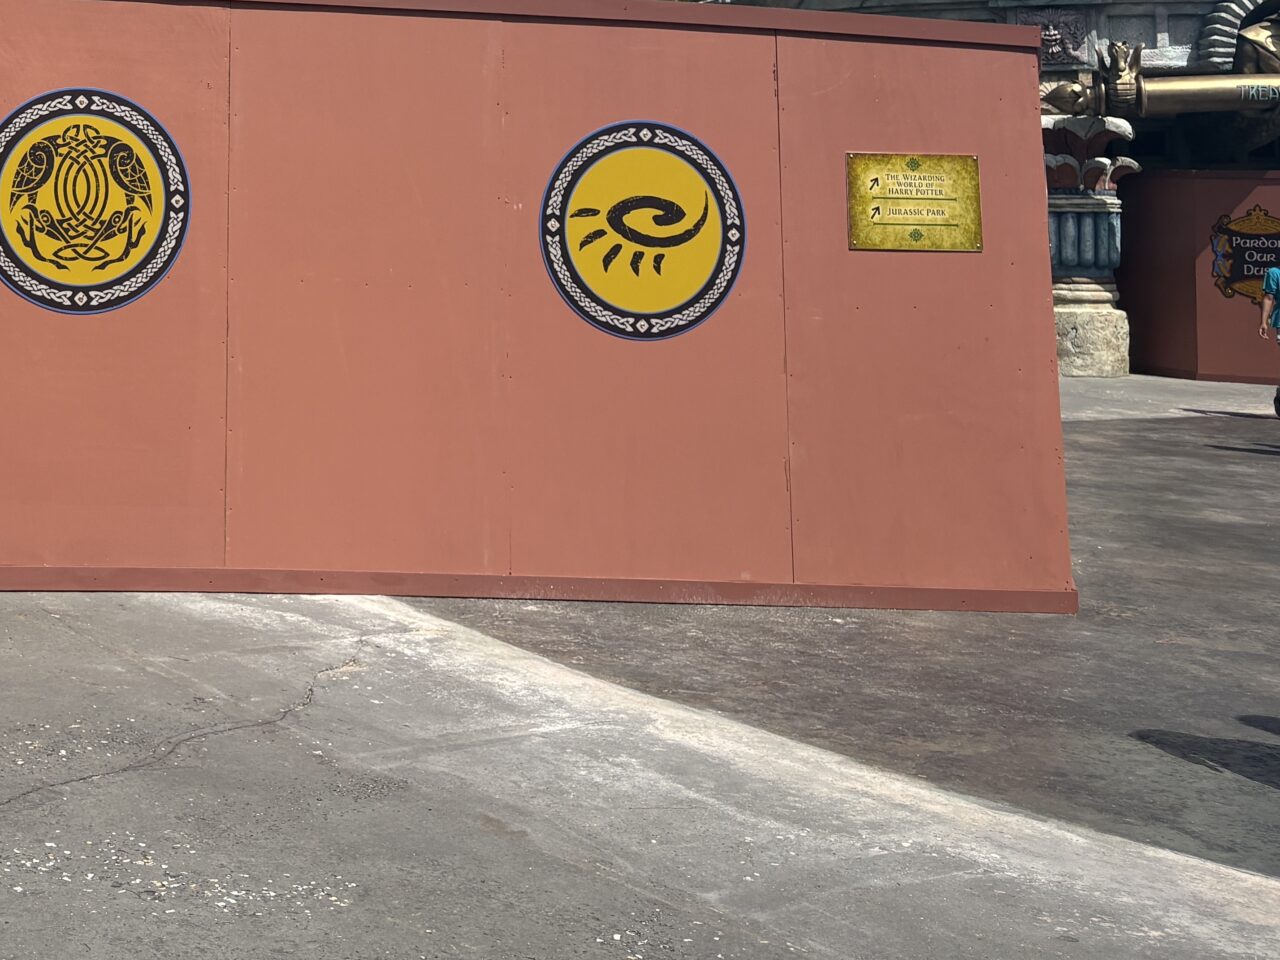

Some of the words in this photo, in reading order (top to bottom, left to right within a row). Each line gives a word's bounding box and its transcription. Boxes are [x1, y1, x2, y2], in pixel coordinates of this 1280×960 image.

[1236, 84, 1280, 101] TREA
[902, 174, 945, 182] WIZARDING
[915, 188, 944, 196] POTTER
[887, 208, 925, 216] JURASSIC
[926, 208, 946, 216] PARK
[1232, 236, 1280, 248] Pardo
[1245, 250, 1276, 262] Our
[1243, 264, 1270, 276] Dus
